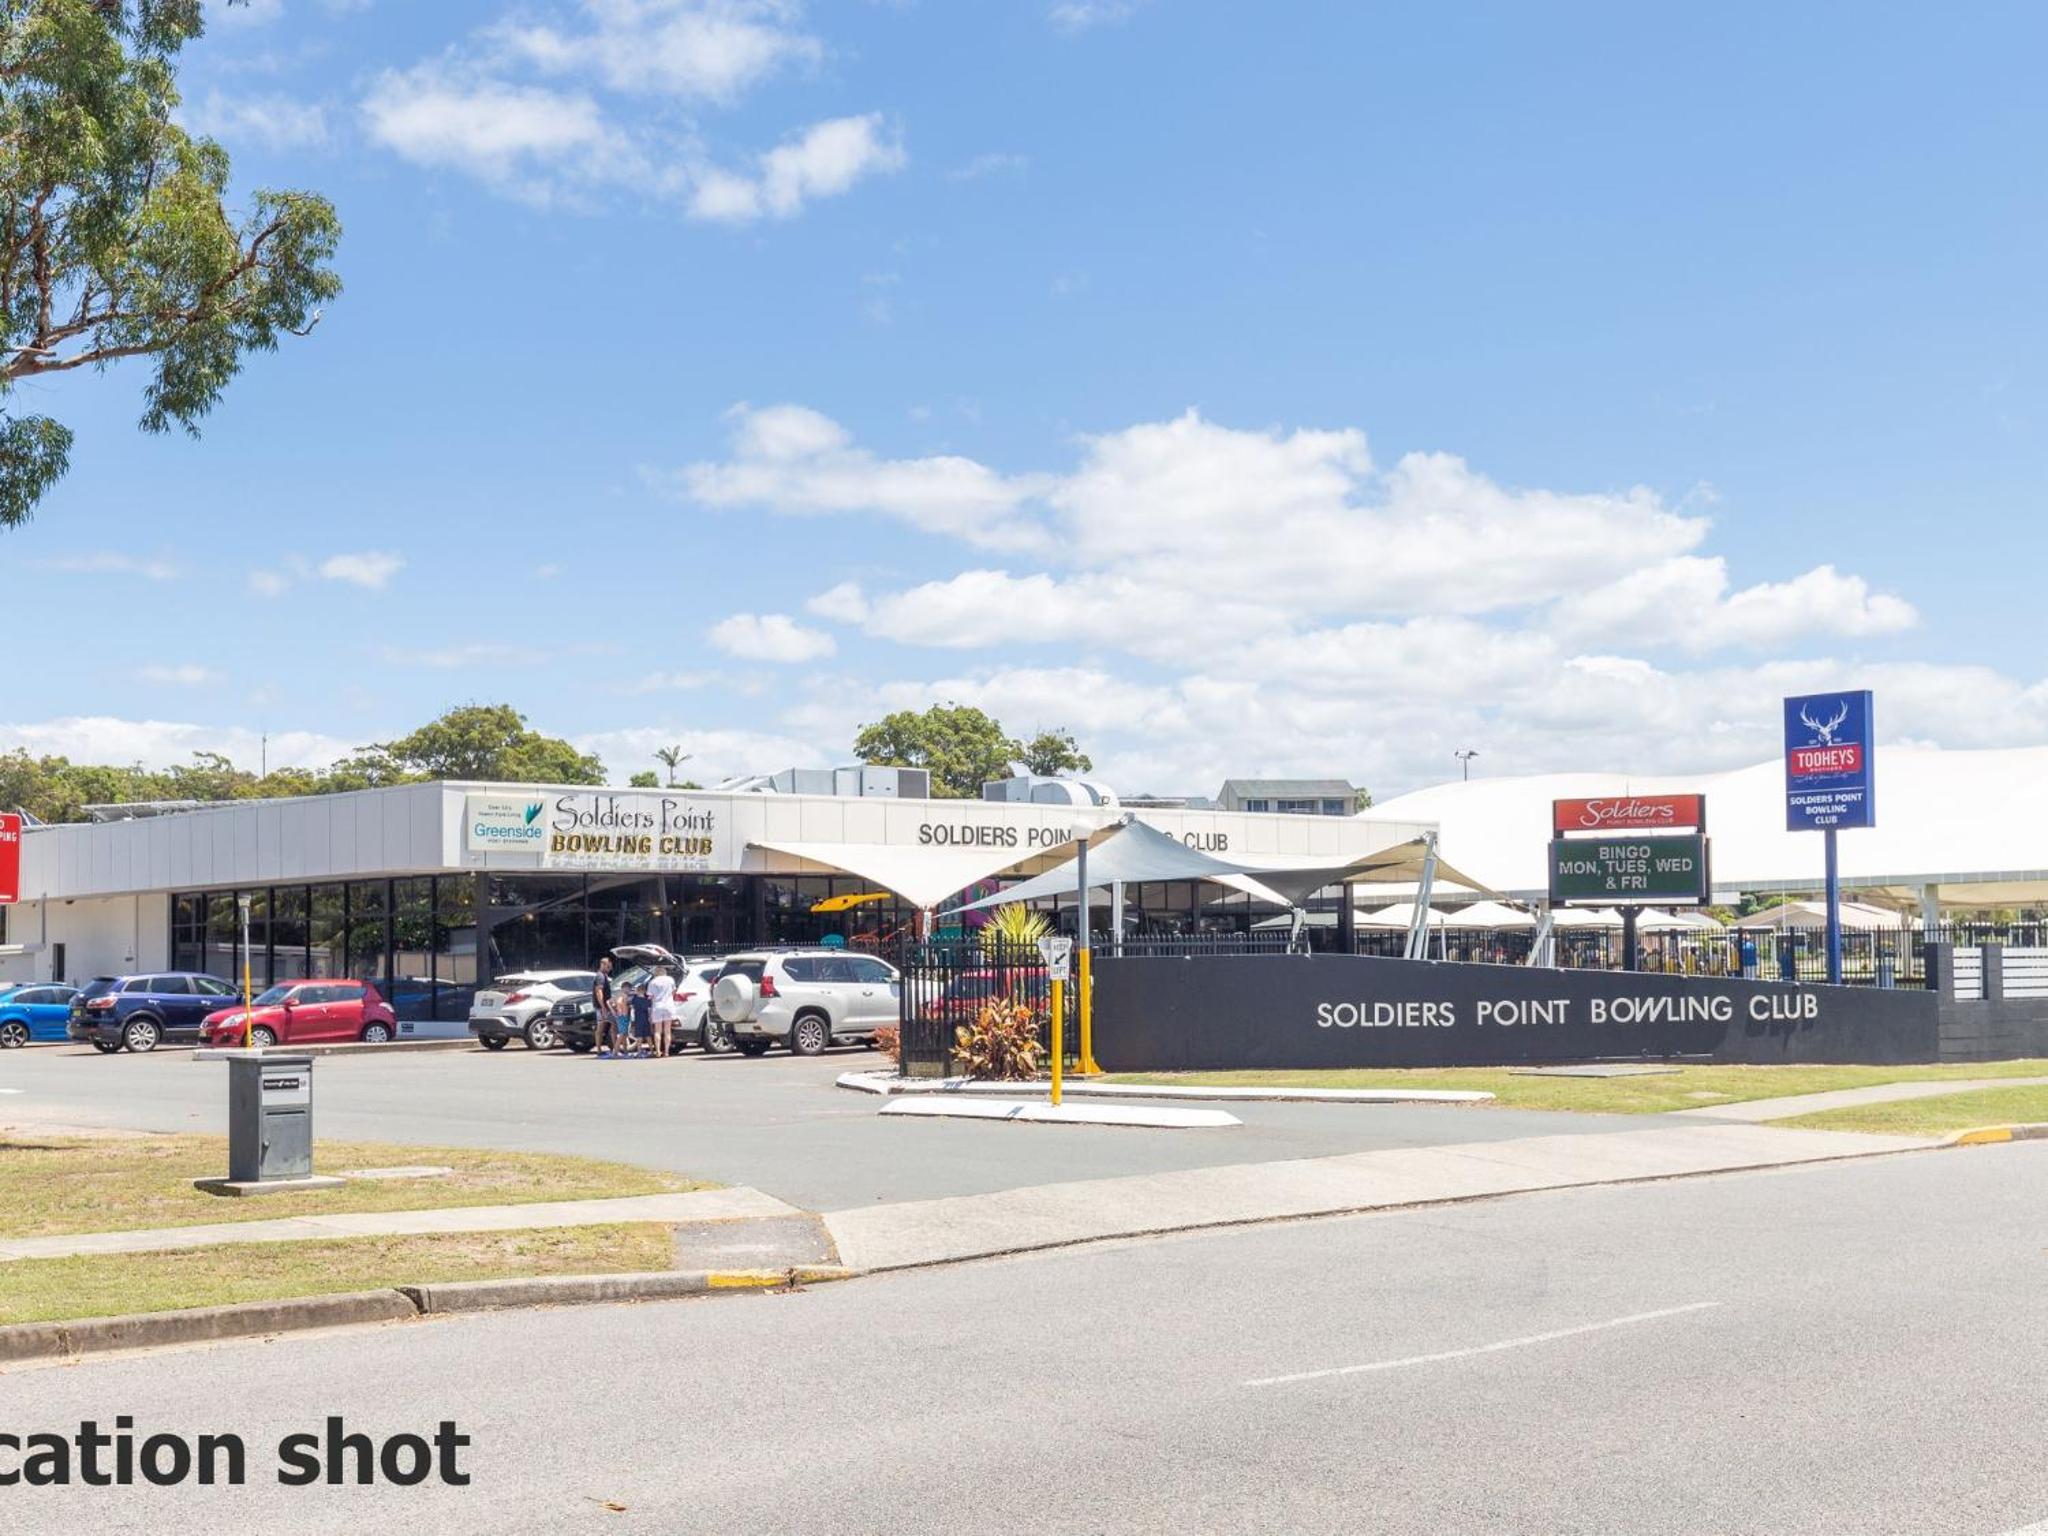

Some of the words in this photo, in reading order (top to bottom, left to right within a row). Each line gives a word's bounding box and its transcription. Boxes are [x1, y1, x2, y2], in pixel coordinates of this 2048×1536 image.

[1797, 749, 1854, 768] TOOHEYS
[1790, 794, 1832, 805] SOLDIERS
[1835, 792, 1862, 802] POINT
[552, 796, 654, 832] Soldiers
[661, 799, 715, 833] Point
[1580, 800, 1674, 826] Soldiers
[1806, 804, 1847, 815] BOWLING
[1815, 815, 1837, 824] CLUB
[474, 822, 542, 838] Greenside
[919, 823, 1018, 847] SOLDIERS
[1028, 827, 1072, 847] POIN
[552, 833, 651, 854] BOWLING
[659, 834, 713, 855] CLUB
[1184, 832, 1228, 851] CLUB
[1600, 846, 1651, 860] BINGO
[1559, 861, 1601, 875] MON,
[1606, 859, 1651, 874] TUES,
[1656, 858, 1693, 872] WED
[1606, 876, 1617, 889] &
[1621, 876, 1647, 889] FRI
[1317, 1002, 1455, 1028] SOLDIERS
[1477, 1000, 1570, 1026] POINT
[1592, 996, 1732, 1023] BOWLING
[1749, 993, 1818, 1019] CLUB
